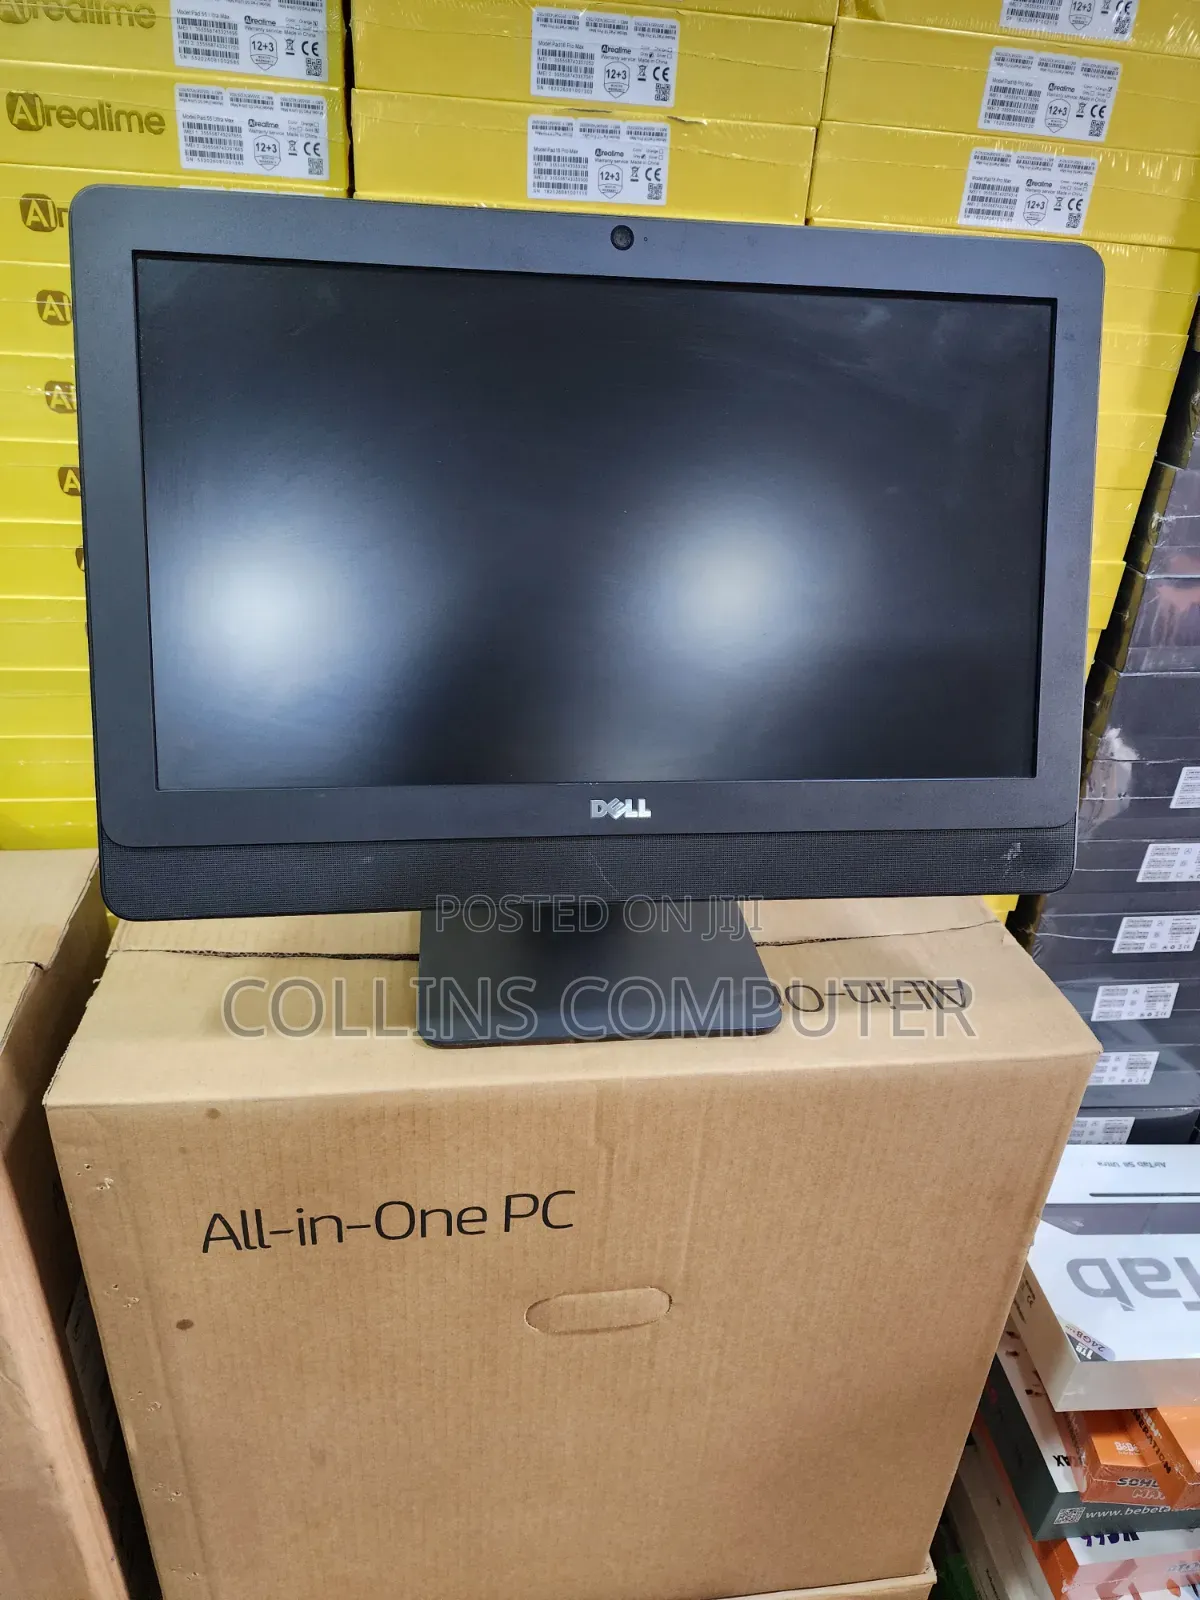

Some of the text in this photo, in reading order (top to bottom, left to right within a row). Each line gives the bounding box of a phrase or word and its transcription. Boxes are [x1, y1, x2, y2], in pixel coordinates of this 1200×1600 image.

[1072, 1, 1092, 13] 12+3
[252, 40, 274, 52] 12+3
[606, 69, 627, 80] 12+3
[1048, 106, 1068, 116] 12+3
[255, 142, 277, 153] 12+3
[600, 171, 620, 182] 12+3
[1026, 200, 1045, 210] 12+3
[590, 798, 651, 820] DELL
[772, 979, 967, 1012] All-in-O
[202, 1190, 575, 1253] All-in-One PC
[1076, 1345, 1093, 1359] 1TB
